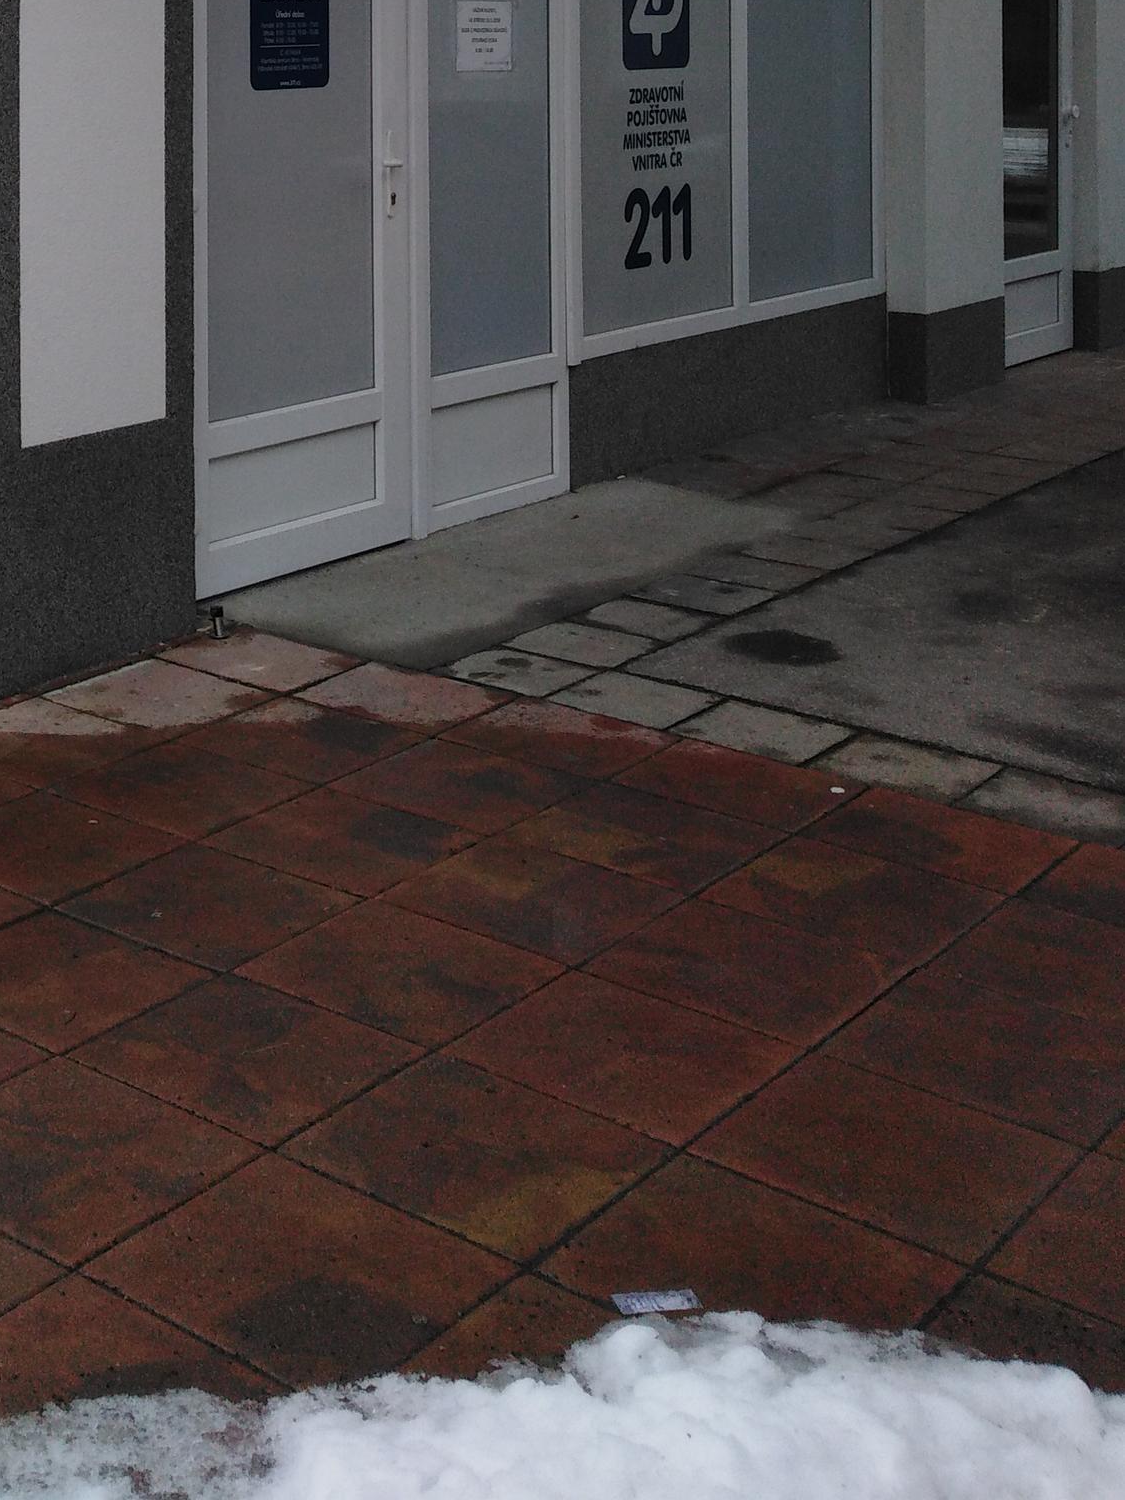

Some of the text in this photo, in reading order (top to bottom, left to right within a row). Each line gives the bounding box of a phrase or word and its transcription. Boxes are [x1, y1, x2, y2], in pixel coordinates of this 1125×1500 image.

[629, 80, 684, 105] ZDRAVOTNÍ
[626, 104, 687, 127] POJIŠŤOVNA
[623, 129, 691, 150] MINISTERSTVA
[632, 147, 683, 171] VNITRA ČR
[624, 183, 692, 270] 211
